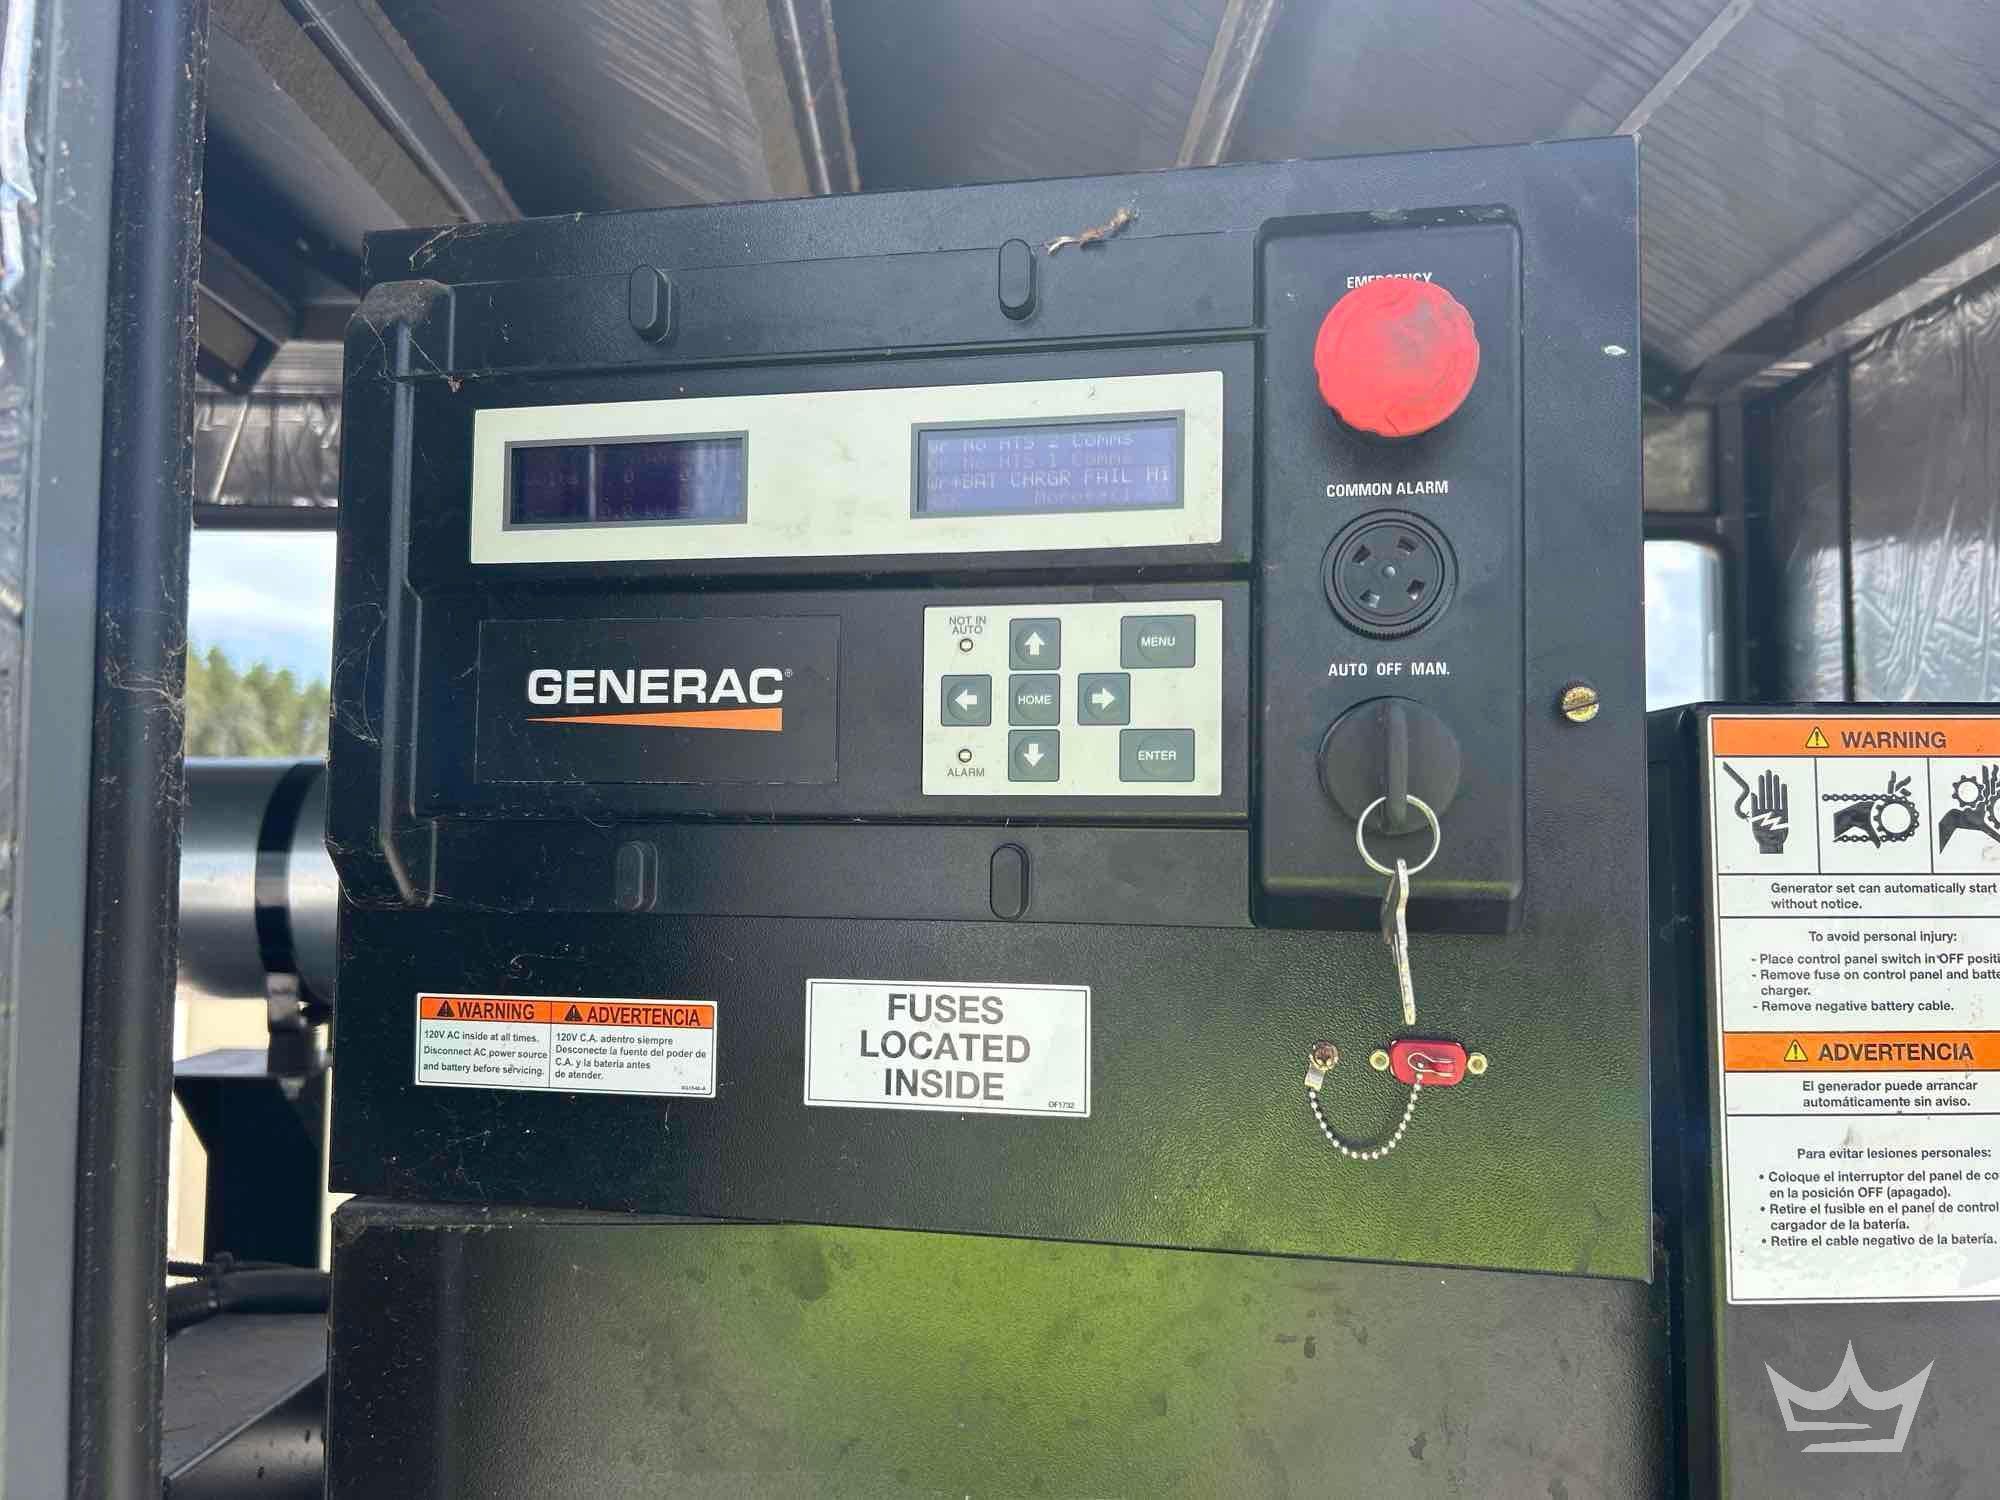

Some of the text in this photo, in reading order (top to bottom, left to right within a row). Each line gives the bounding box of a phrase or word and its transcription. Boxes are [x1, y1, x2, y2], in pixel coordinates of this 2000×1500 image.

[1326, 480, 1449, 497] COMMON ALARM
[949, 615, 986, 625] NOT IN
[952, 625, 983, 635] AUTO
[1141, 637, 1175, 647] MENU
[1328, 661, 1450, 677] AUTO OFF MAN.
[528, 668, 783, 705] GENERAC
[1018, 695, 1052, 705] HOME
[1841, 731, 1946, 748] WARNING
[1137, 750, 1177, 761] ENTER
[947, 767, 985, 777] ALARM
[1771, 882, 1997, 896] Generator set can automatically start
[1771, 898, 1862, 909] without notice.
[1808, 931, 1957, 944] To avoid personal injury:
[1760, 953, 1794, 965] Place
[1797, 953, 1841, 964] control
[1845, 953, 1877, 967] panel
[1881, 953, 1921, 964] switch
[1924, 953, 1936, 964] in
[1939, 952, 1964, 964] OFF
[1760, 969, 1810, 980] Remove
[1814, 969, 1840, 980] fuse
[1844, 971, 1859, 980] on
[1863, 968, 1906, 980] control
[1910, 968, 1943, 983] panel
[1946, 968, 1968, 980] and
[1761, 985, 1811, 998] charger.
[457, 1002, 535, 1020] WARNING
[888, 993, 1004, 1025] FUSES
[1762, 1000, 1954, 1014] Remove negative battery cable.
[587, 1006, 701, 1026] ADVERTENCIA
[425, 1029, 539, 1043] 120V AC inside at all times.
[555, 1033, 578, 1042] 120V
[600, 1034, 634, 1044] adentro
[637, 1036, 673, 1046] siempre
[423, 1045, 547, 1059] Disconnect AC power source
[555, 1044, 706, 1059] Desconecte la fuente del poder de
[860, 1029, 1031, 1063] LOCATED
[1818, 1043, 1974, 1061] ADVERTENCIA
[423, 1062, 544, 1077] and battery before servicing.
[576, 1060, 581, 1068] y
[583, 1058, 592, 1067] la
[626, 1061, 650, 1070] antes
[555, 1069, 604, 1080] de atender.
[884, 1067, 1005, 1101] INSIDE
[1802, 1080, 1978, 1094] El generador puede arrancar
[1803, 1096, 1971, 1108] automáticamente sin aviso.
[1797, 1147, 1992, 1161] Para evitar lesiones personales:
[1768, 1171, 1820, 1184] Coloque
[1824, 1171, 1834, 1182] el
[1838, 1171, 1903, 1184] interruptor
[1907, 1170, 1925, 1182] del
[1929, 1170, 1962, 1184] panel
[1966, 1169, 1981, 1181] de
[1769, 1186, 1951, 1200] en la posición OFF (apagado).
[1770, 1201, 1999, 1215] Retire el fusible en el panel de control
[1770, 1218, 1910, 1233] cargador de la batería.
[1771, 1233, 1997, 1248] Retire el cable negativo de la batería.
